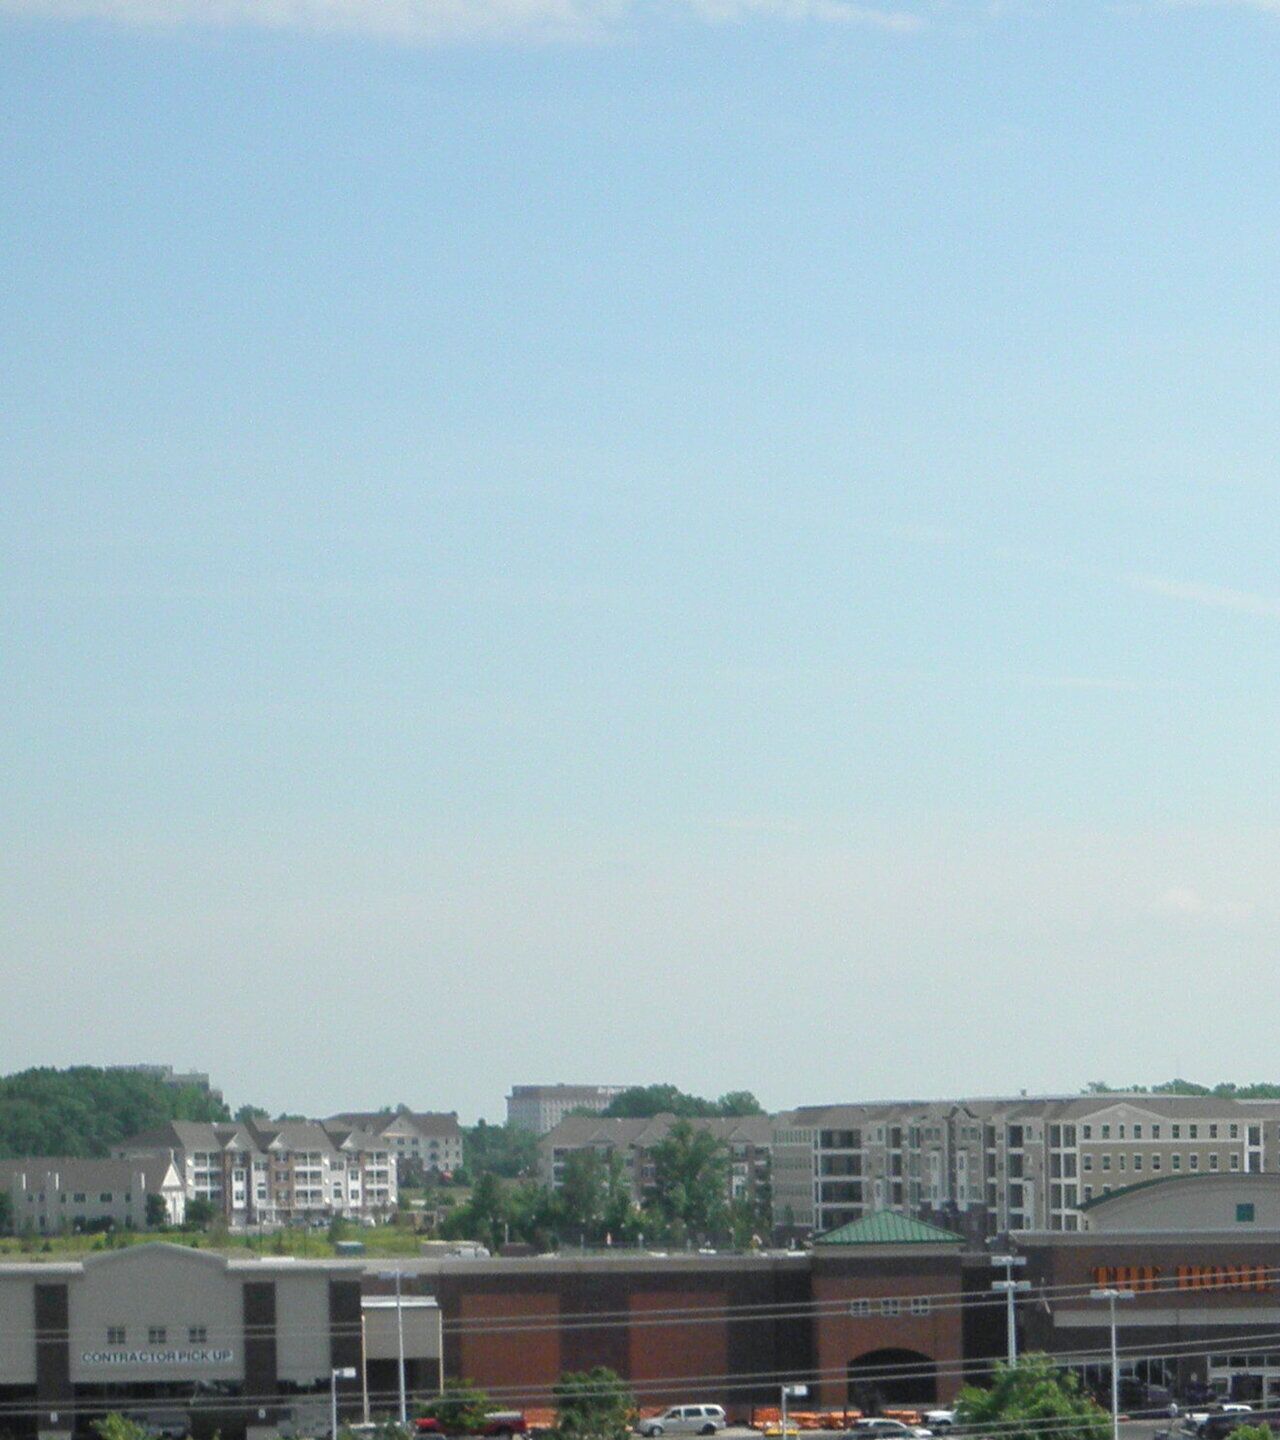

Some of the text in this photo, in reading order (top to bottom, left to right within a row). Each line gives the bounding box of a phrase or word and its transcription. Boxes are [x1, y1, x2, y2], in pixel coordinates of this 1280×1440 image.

[1091, 1265, 1161, 1292] THE
[1177, 1265, 1277, 1292] HOME
[82, 1350, 232, 1363] CONTRACTOR PICK UP
